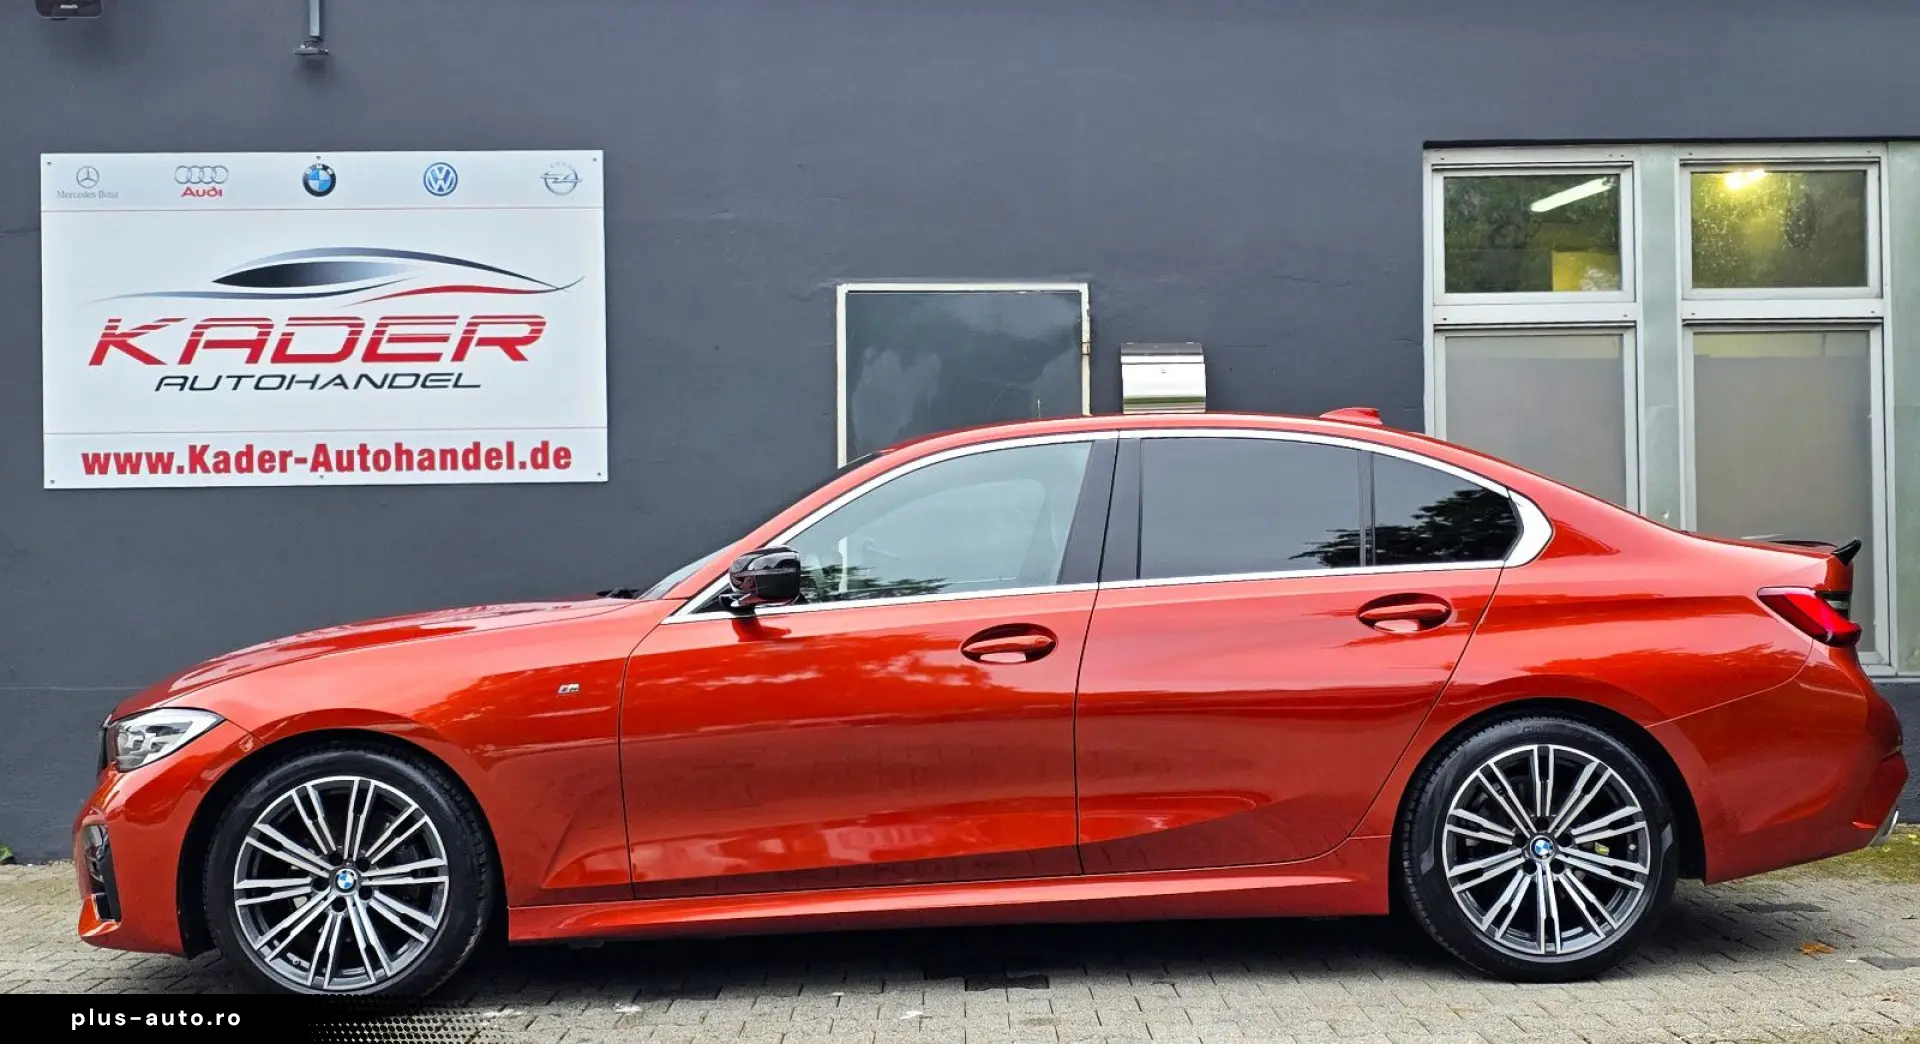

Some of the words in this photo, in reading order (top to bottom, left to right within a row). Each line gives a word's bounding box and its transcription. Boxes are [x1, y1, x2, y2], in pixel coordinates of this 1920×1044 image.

[180, 186, 223, 198] Audi
[88, 313, 546, 366] KADER
[154, 372, 482, 392] AUTOHANDEL
[81, 440, 572, 475] www.Kader-Autohandel.de
